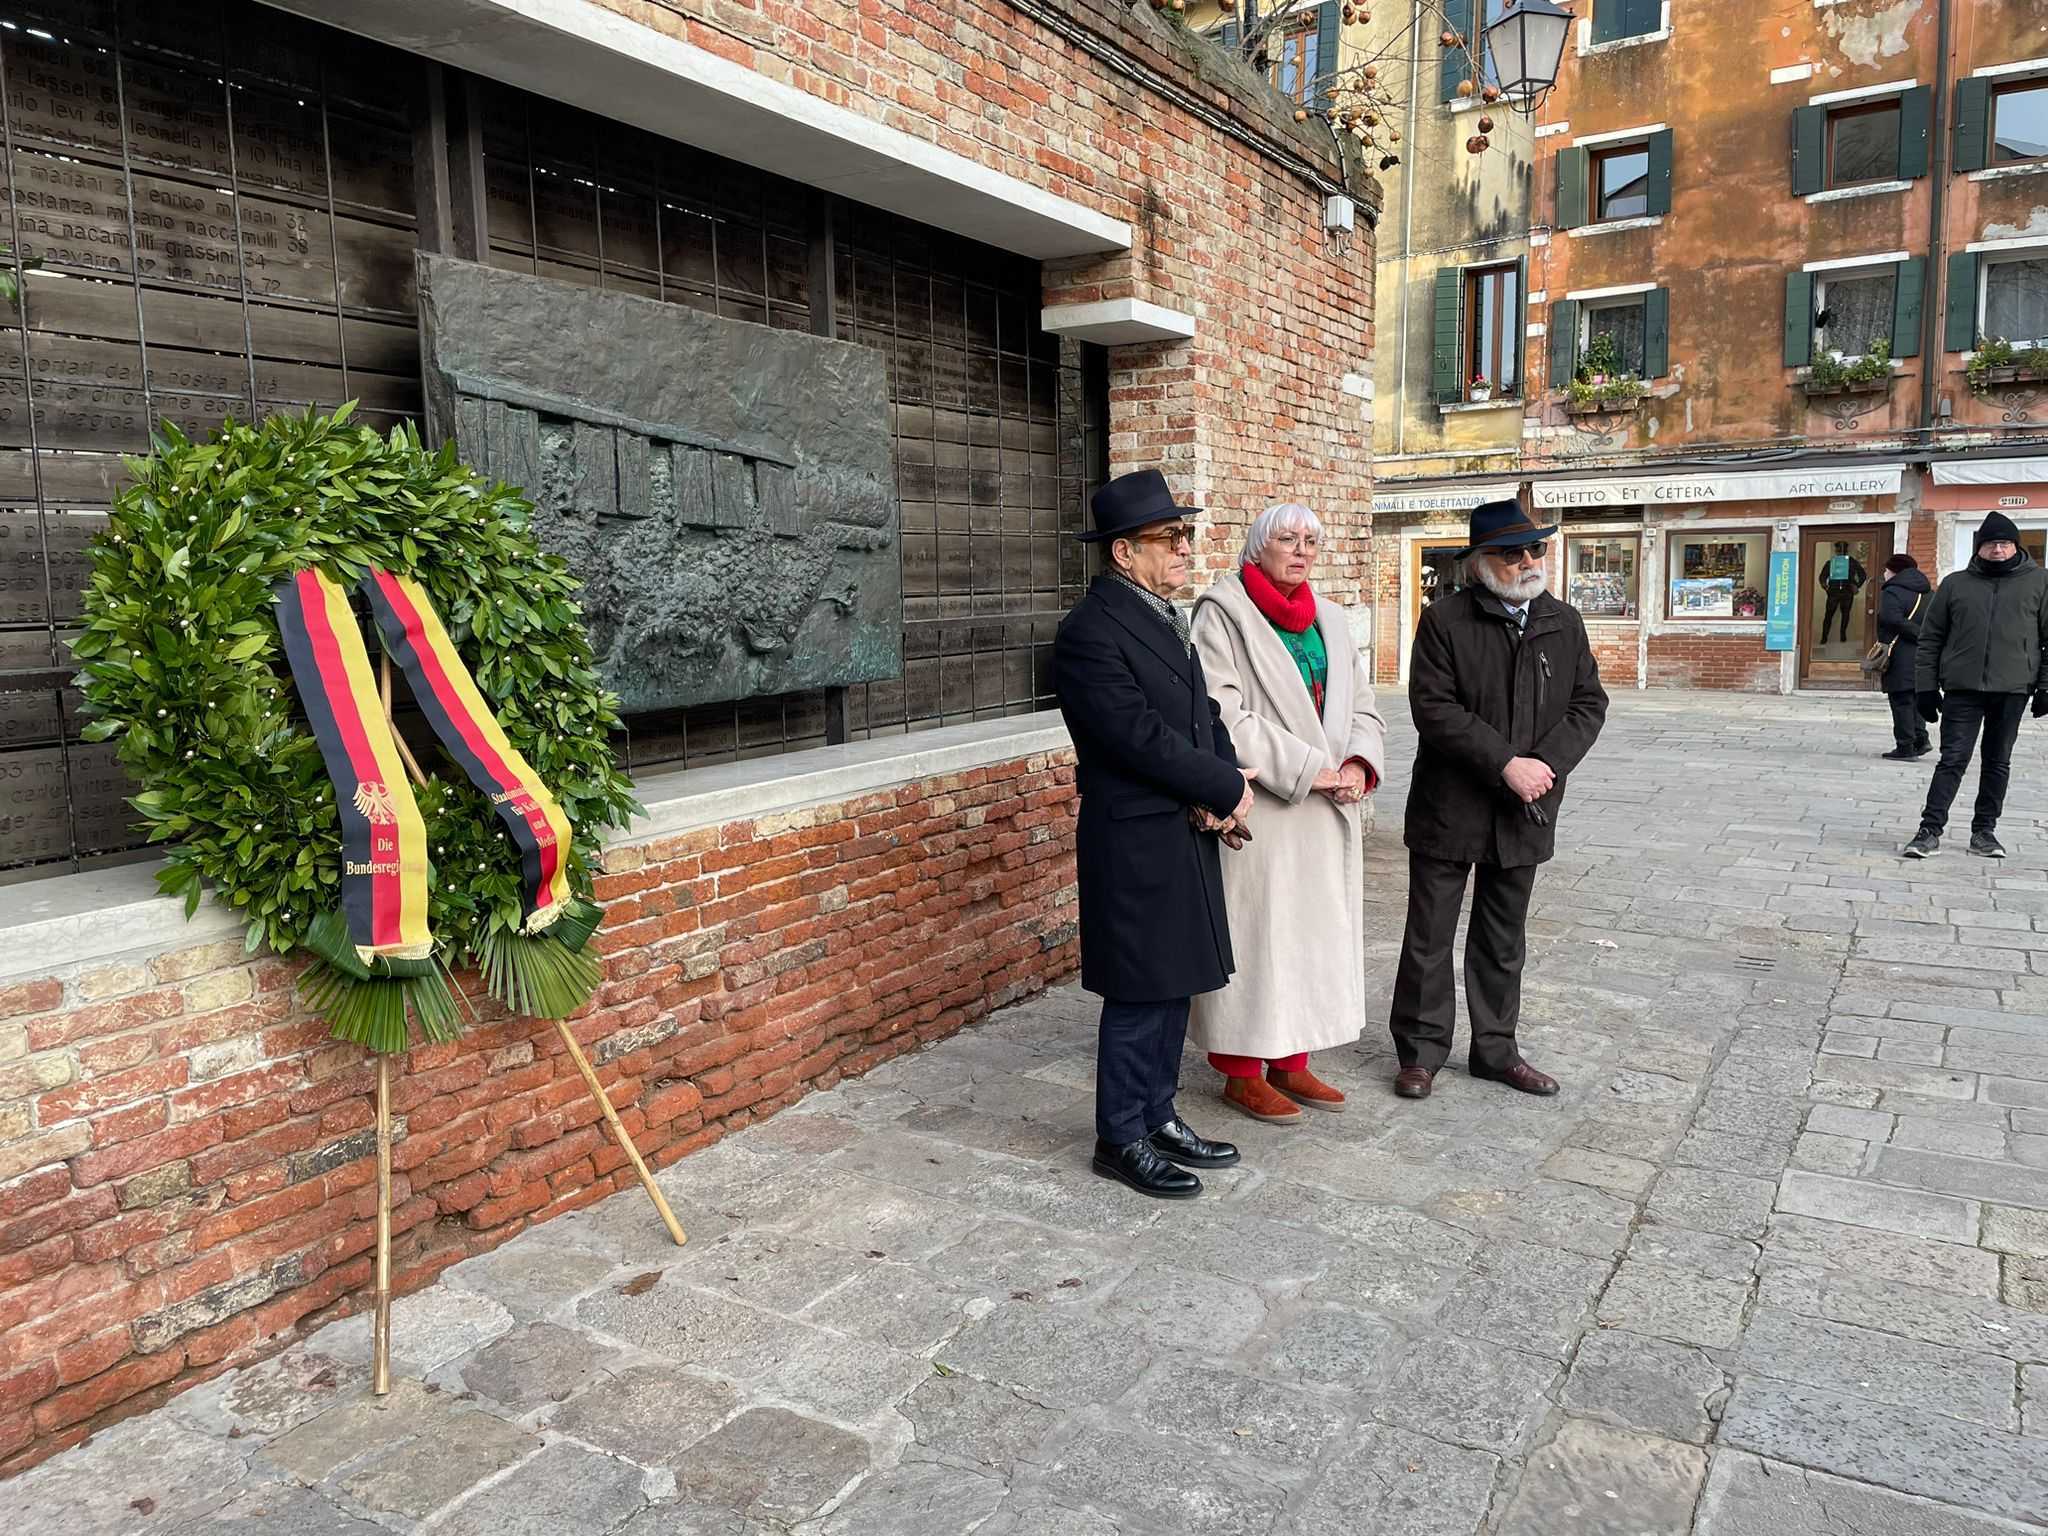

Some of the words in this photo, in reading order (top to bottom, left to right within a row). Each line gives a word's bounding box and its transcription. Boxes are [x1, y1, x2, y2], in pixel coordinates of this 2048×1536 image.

[50, 98, 83, 121] levi
[94, 110, 119, 130] 49
[149, 189, 205, 211] enrico
[215, 202, 276, 225] mriani
[286, 213, 307, 232] 32
[62, 223, 154, 250] nacamlli
[166, 241, 234, 265] grassini
[185, 221, 278, 249] naccamulli
[203, 398, 275, 418] ebraca
[1544, 490, 1606, 503] GHETTO
[1622, 488, 1640, 500] ET
[1654, 485, 1716, 499] CETERA
[1789, 483, 1815, 495] ART
[1824, 480, 1888, 493] GALLERY
[1373, 499, 1405, 511] NIMALI
[1409, 500, 1417, 510] E
[377, 837, 394, 852] Die
